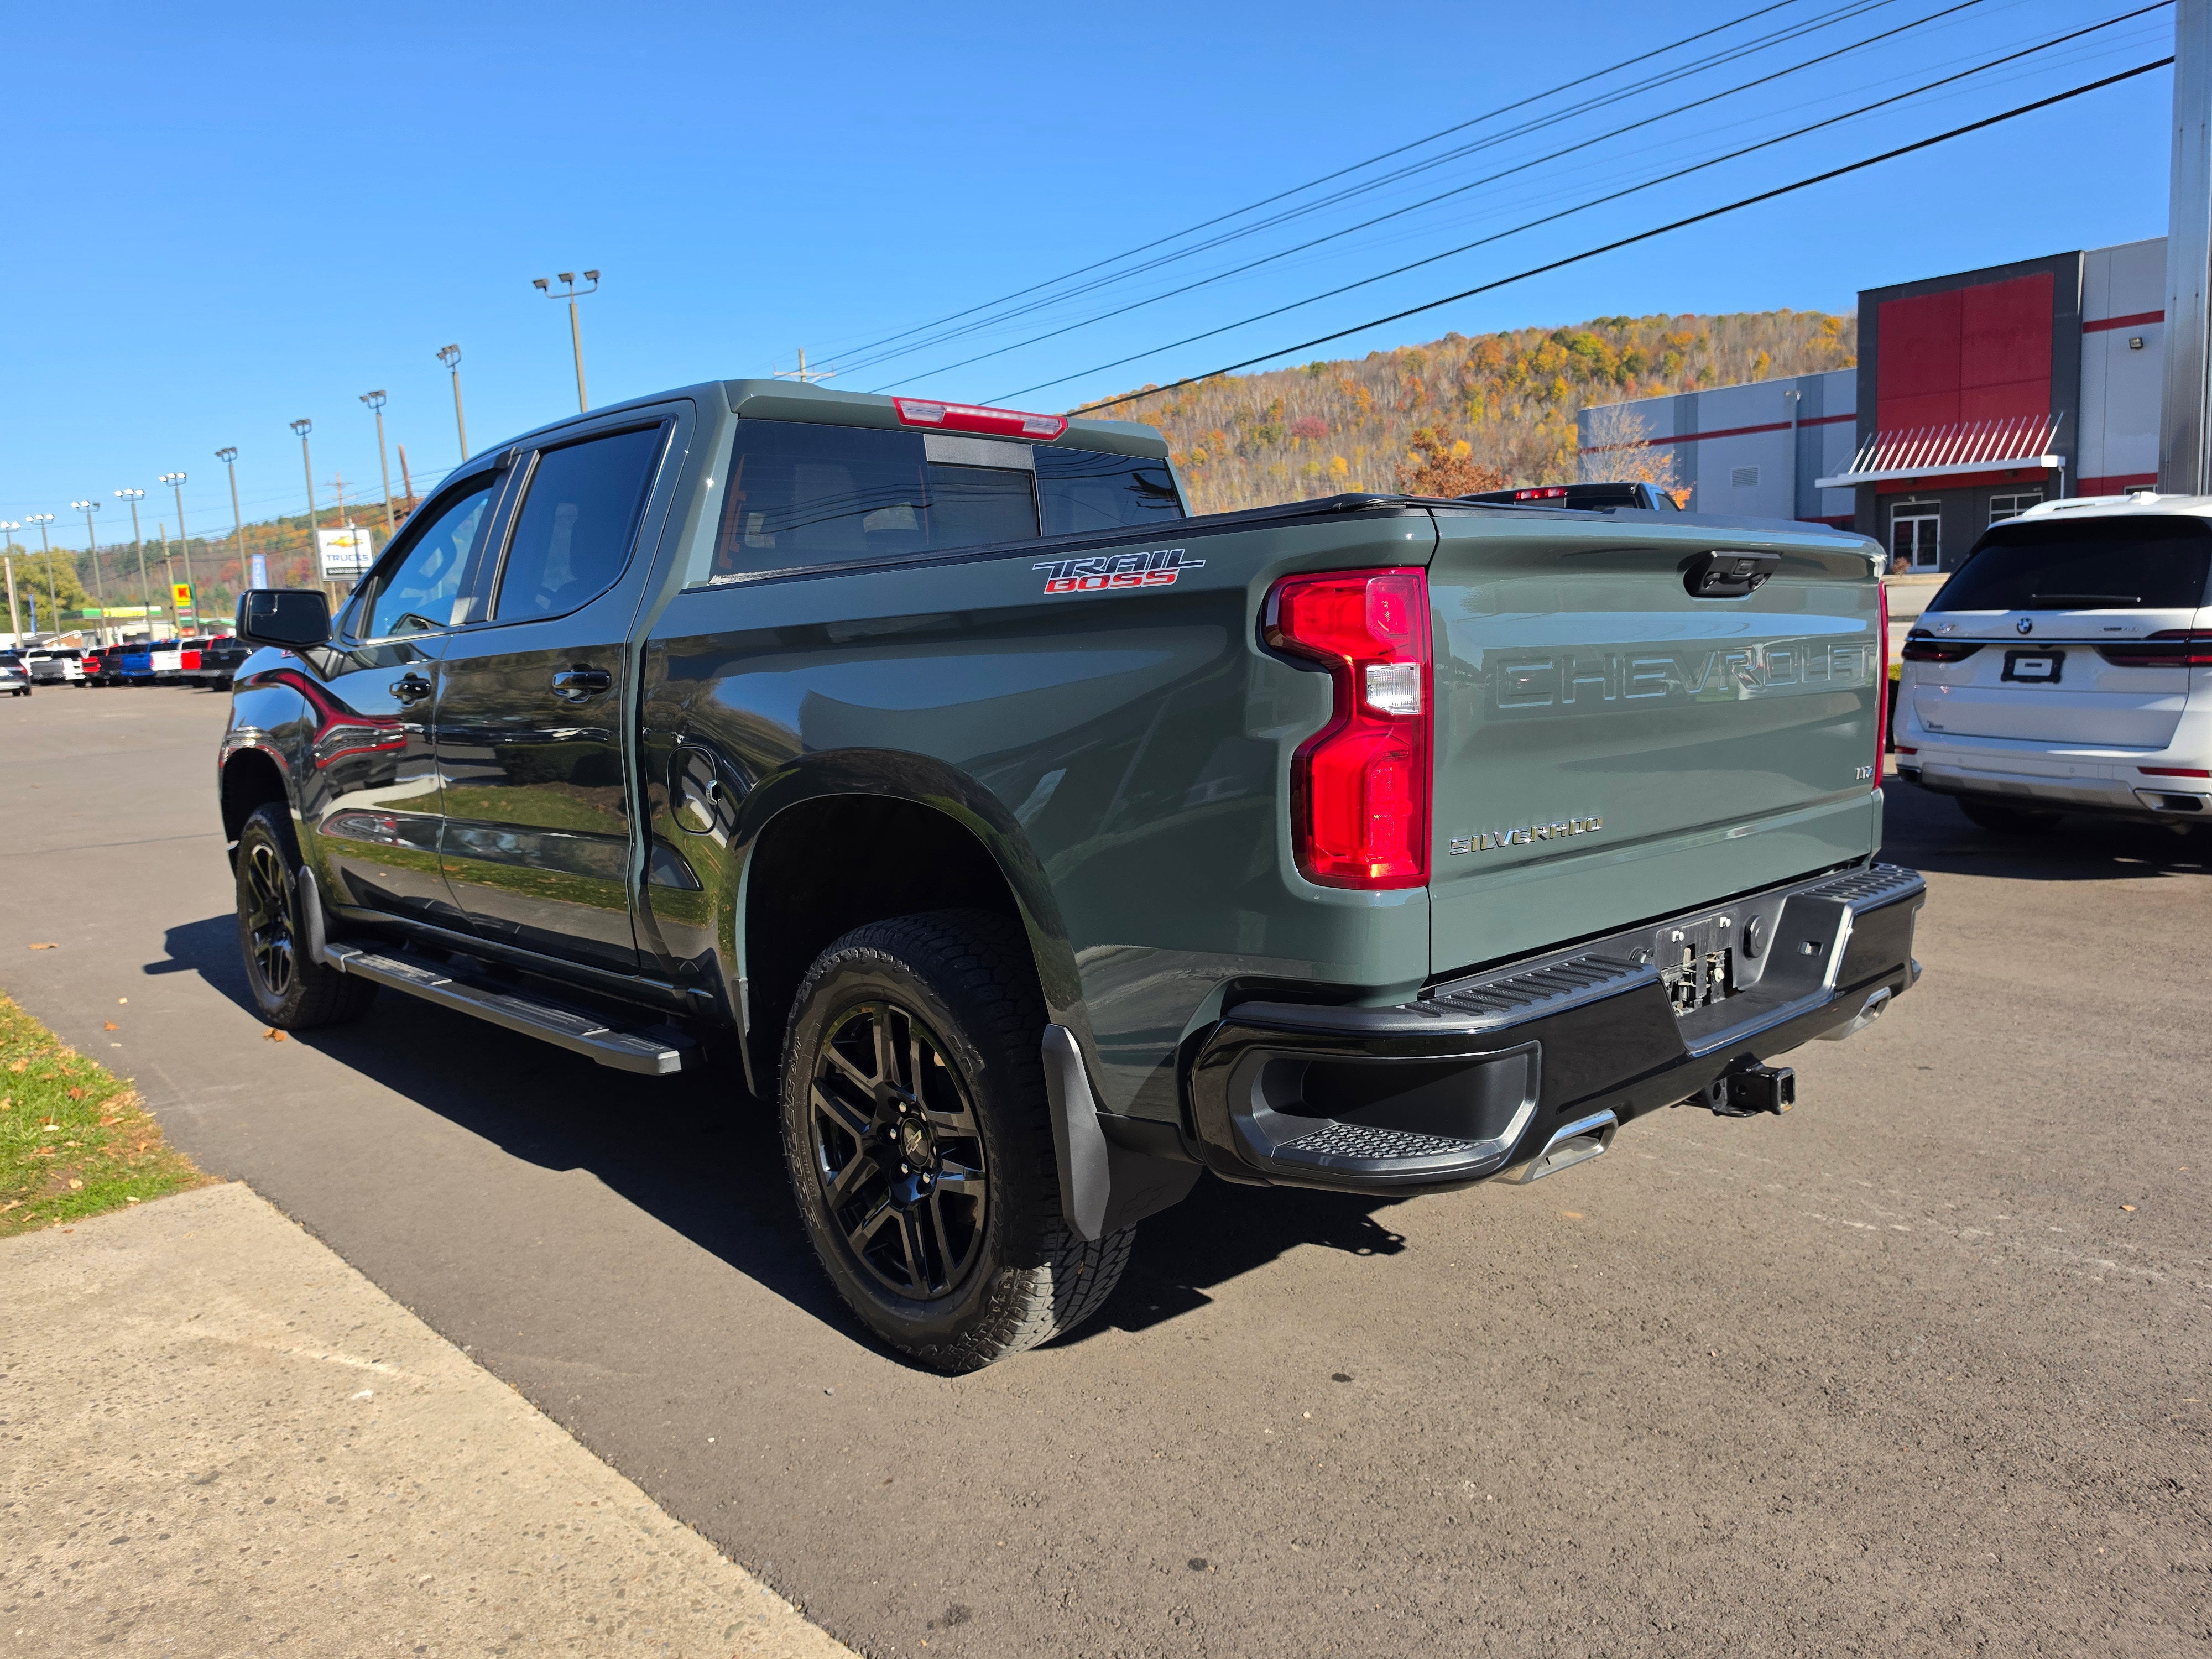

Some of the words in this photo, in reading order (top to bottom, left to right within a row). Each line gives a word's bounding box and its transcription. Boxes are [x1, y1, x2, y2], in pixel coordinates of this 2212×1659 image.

[1032, 548, 1206, 578] TRAIL
[1043, 568, 1180, 594] BOSS
[1496, 641, 1876, 708] CHEVROLET
[1449, 813, 1603, 856] SILVERADO
